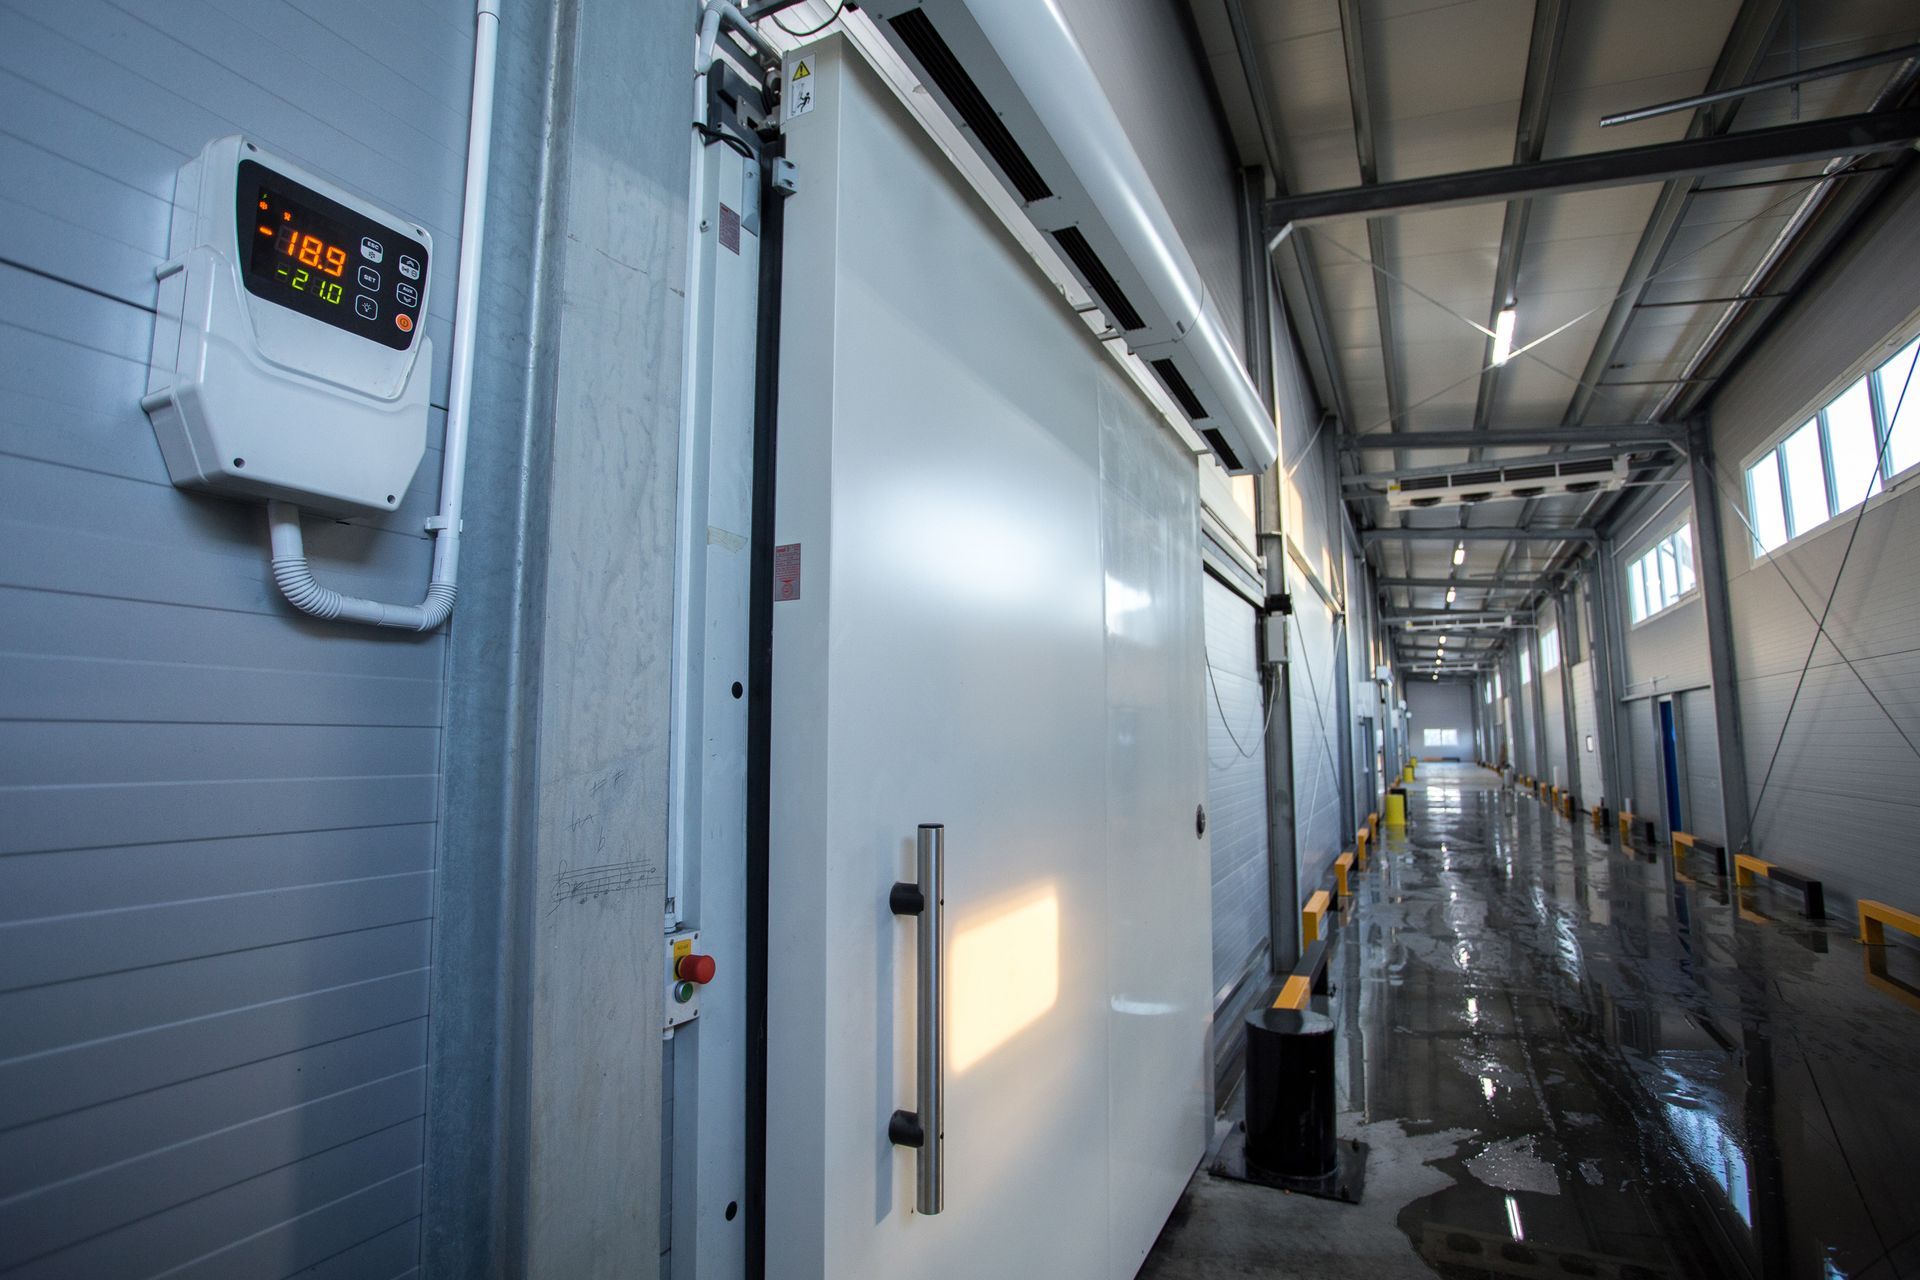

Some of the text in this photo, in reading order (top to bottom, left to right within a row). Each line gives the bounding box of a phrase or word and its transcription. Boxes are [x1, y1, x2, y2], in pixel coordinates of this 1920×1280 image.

[367, 240, 379, 250] ESC
[260, 227, 346, 277] -18.9
[363, 273, 376, 283] SET
[277, 269, 342, 304] -21.0
[402, 286, 414, 295] AUX
